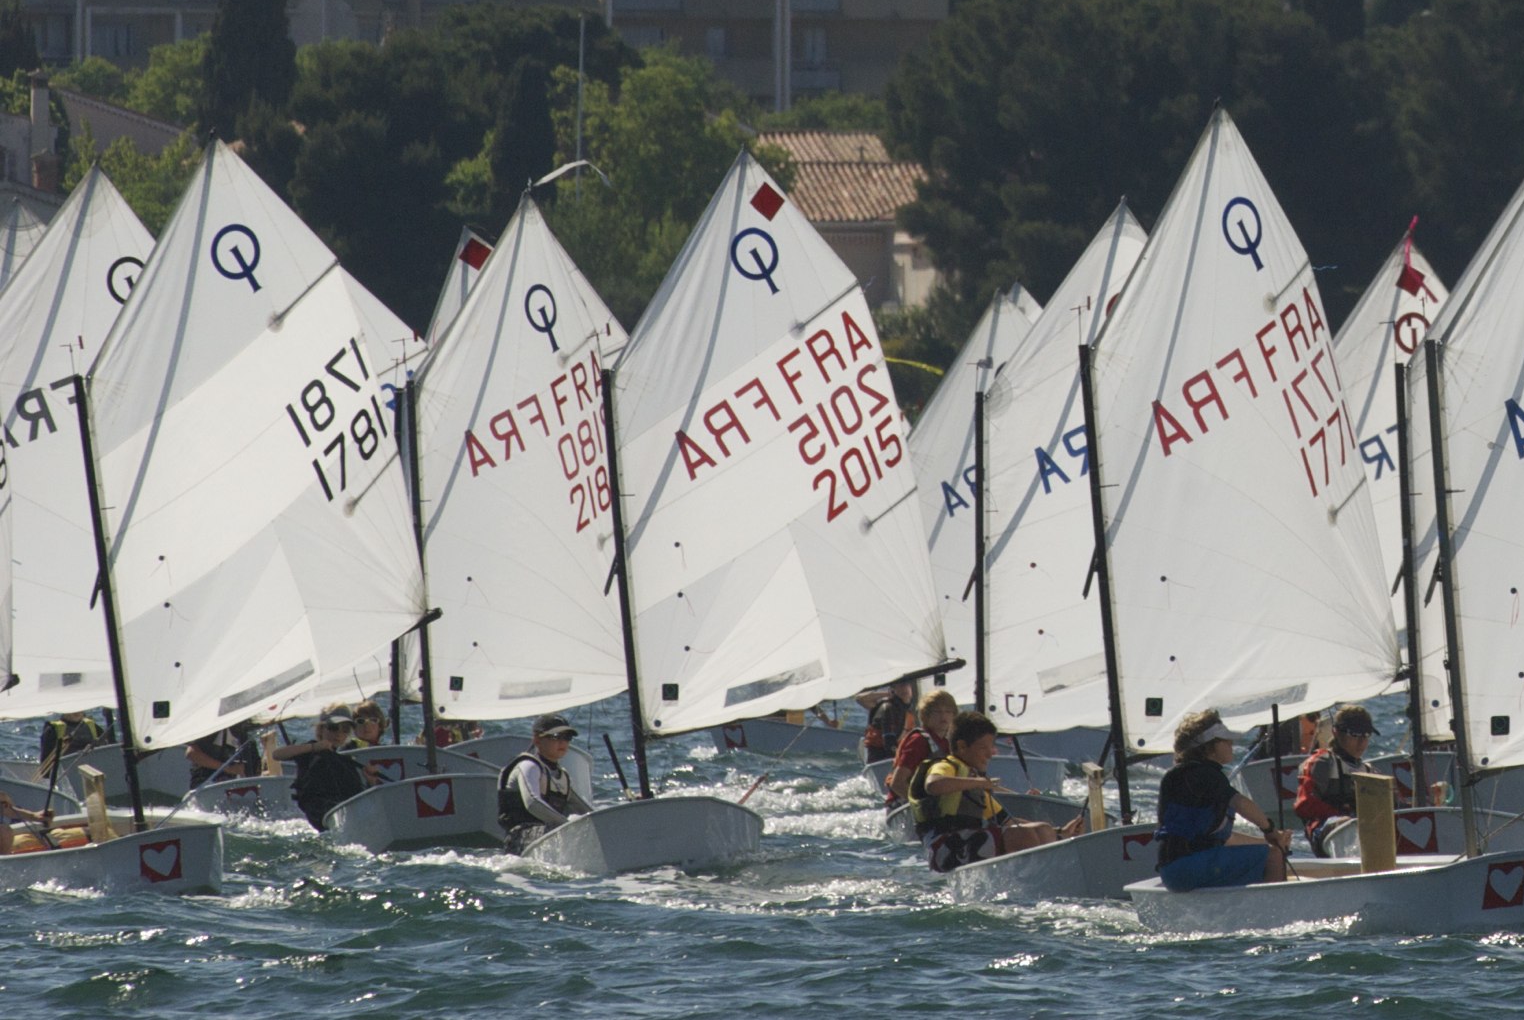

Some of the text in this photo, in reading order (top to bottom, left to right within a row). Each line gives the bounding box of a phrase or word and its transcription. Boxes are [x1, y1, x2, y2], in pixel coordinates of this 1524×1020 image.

[776, 311, 873, 405] FRA
[1256, 286, 1325, 382] FRA
[550, 350, 602, 426] FRA
[312, 394, 388, 502] 1781
[812, 415, 902, 523] 2015
[1301, 399, 1356, 497] 1771
